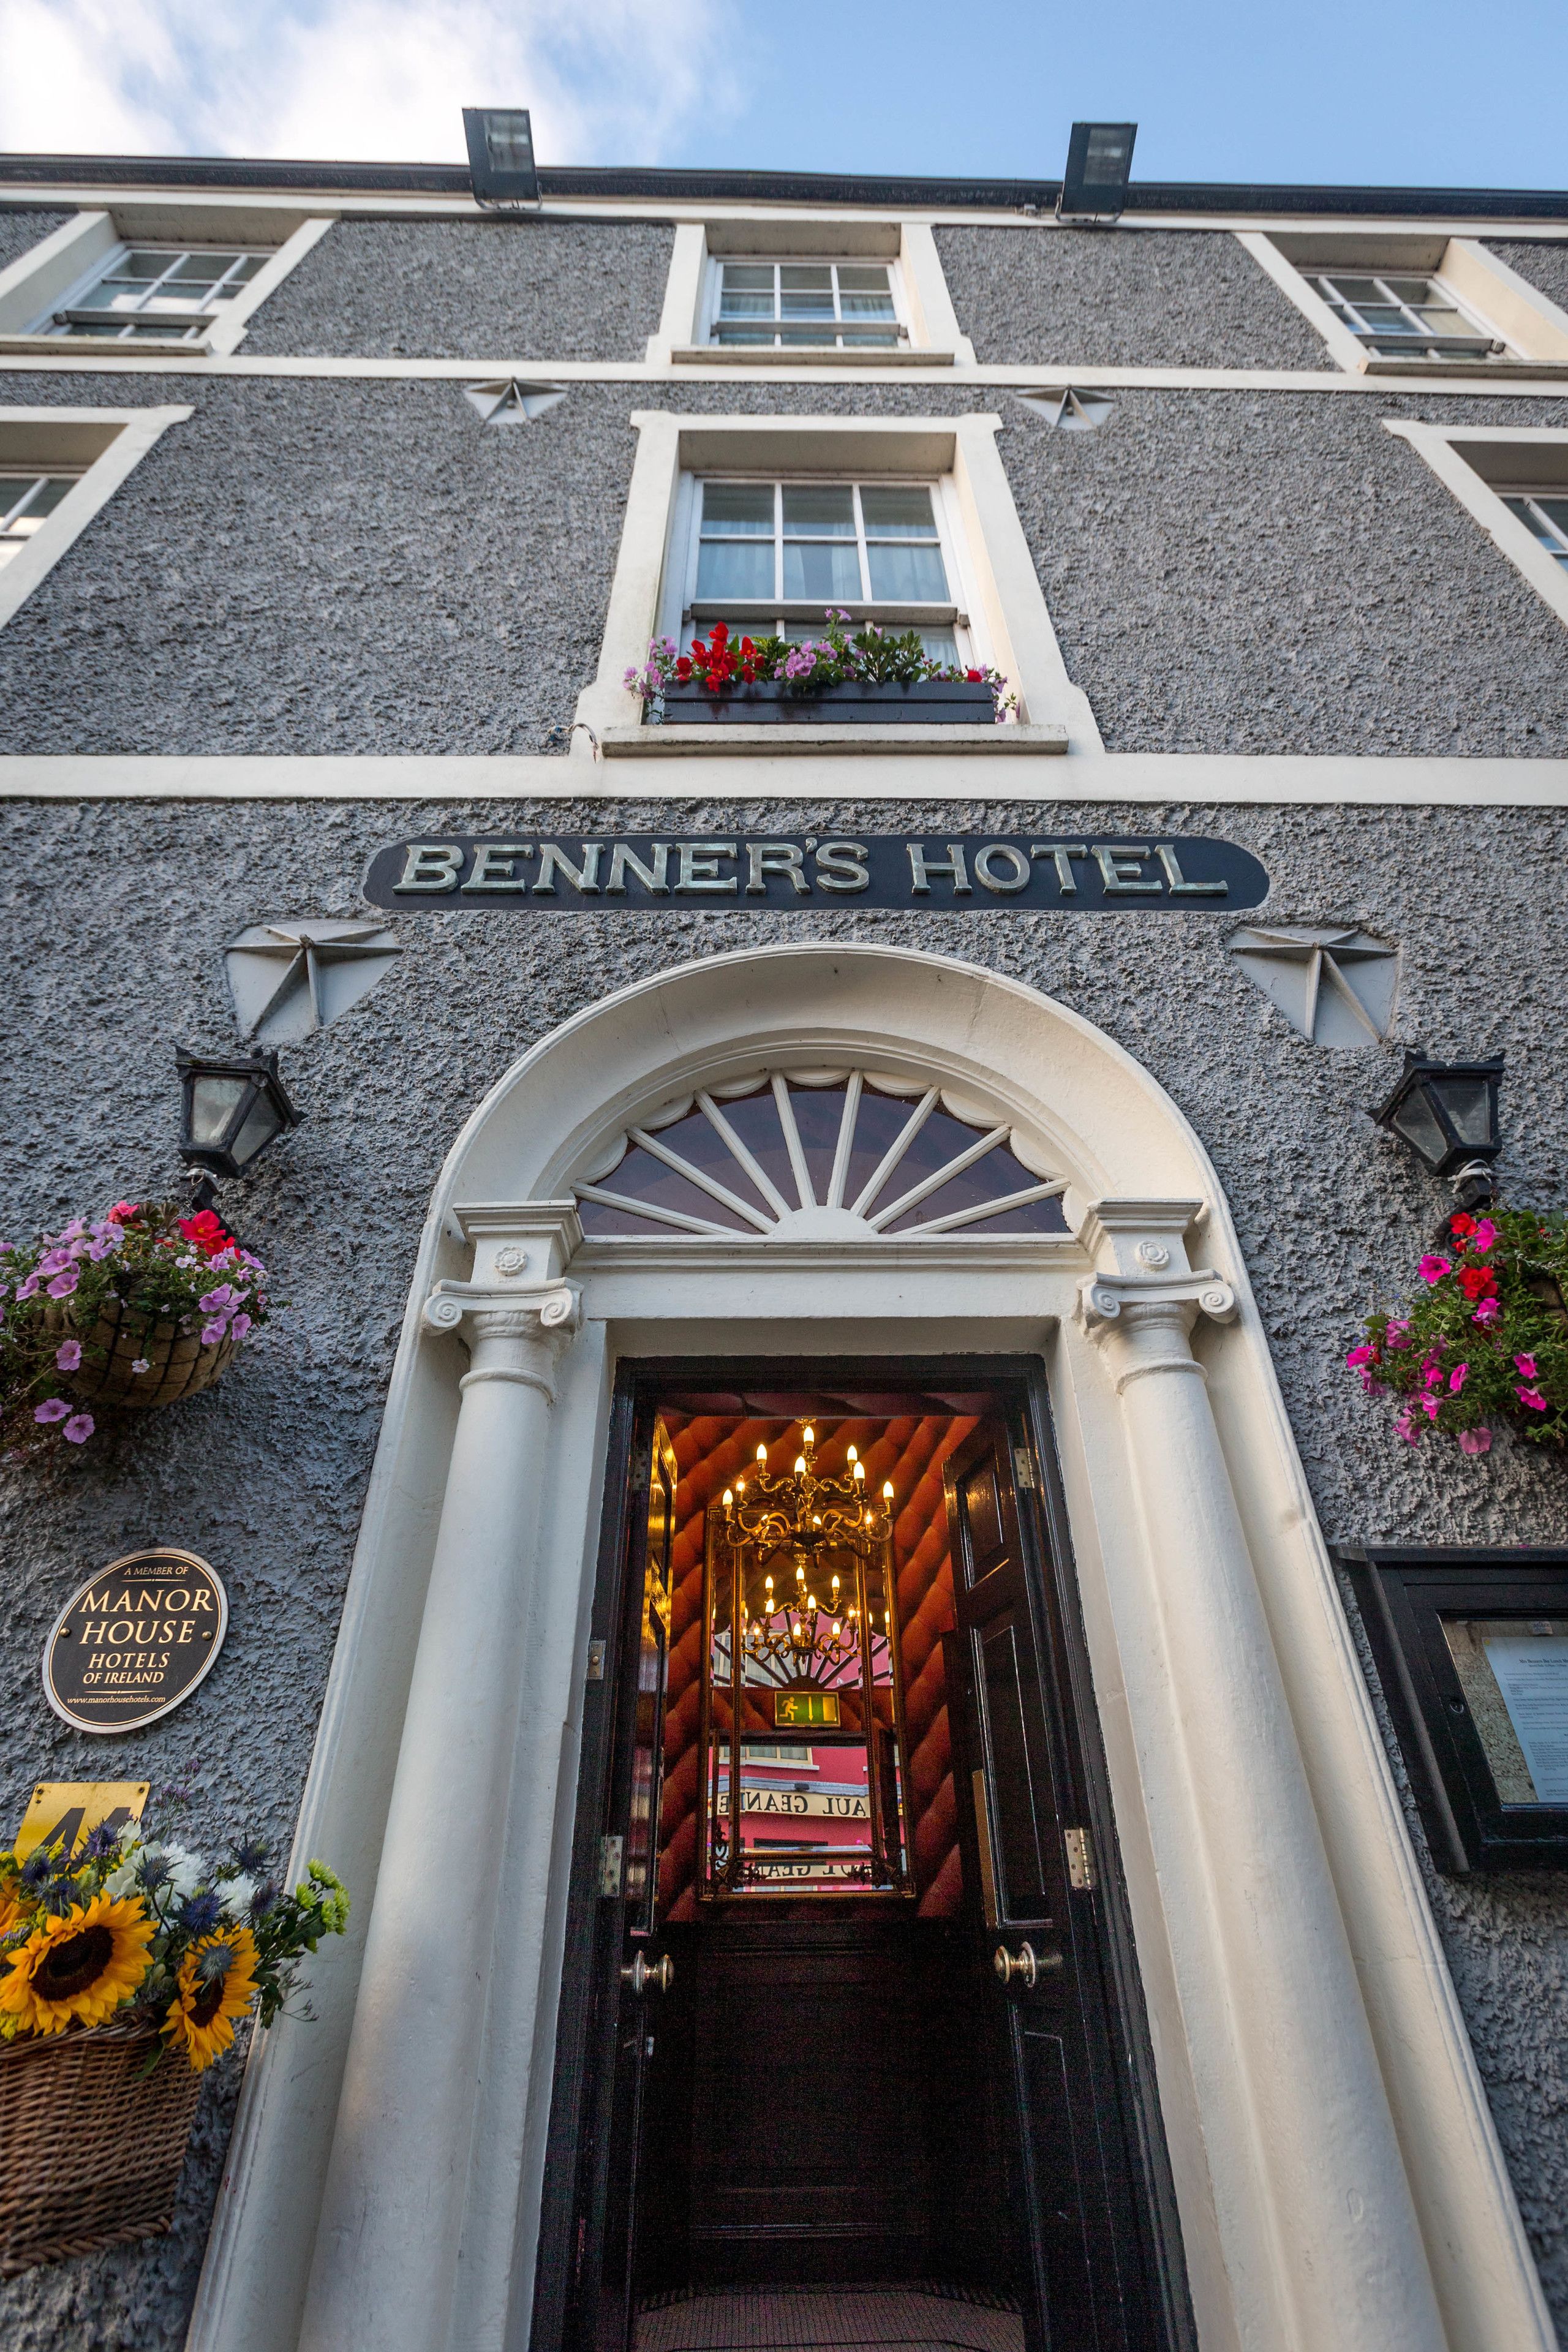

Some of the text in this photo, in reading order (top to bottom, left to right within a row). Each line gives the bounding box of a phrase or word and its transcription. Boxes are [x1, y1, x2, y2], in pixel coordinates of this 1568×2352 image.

[392, 837, 1229, 896] BENNER'S HOTEL
[175, 1566, 189, 1575] OF
[79, 1589, 214, 1612] MANOR
[79, 1620, 196, 1645] HOUSE
[88, 1653, 170, 1669] HOTELS
[83, 1672, 164, 1684] OF IRELAND
[67, 1695, 165, 1704] www.manorhousehotels.com
